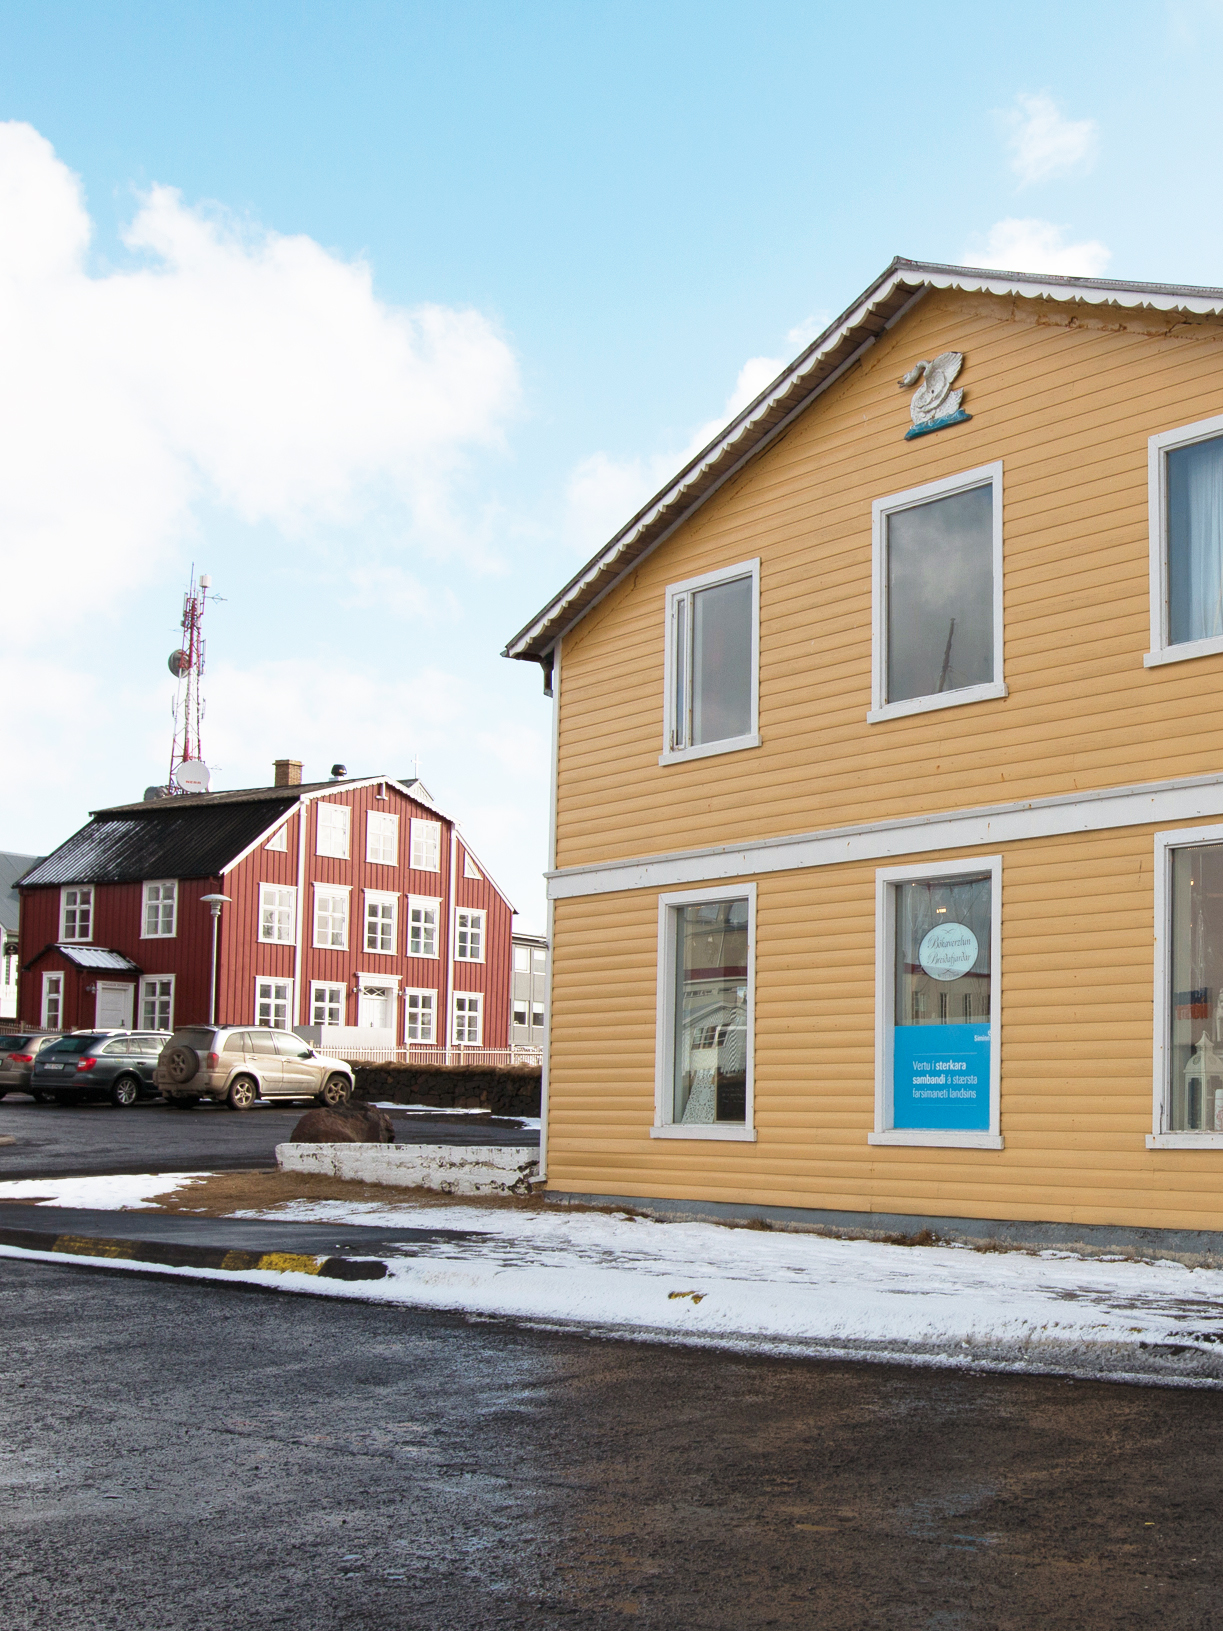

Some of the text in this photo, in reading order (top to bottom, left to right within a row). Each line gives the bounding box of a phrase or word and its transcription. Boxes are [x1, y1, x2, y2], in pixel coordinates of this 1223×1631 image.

[912, 1060, 931, 1071] Vertu
[935, 1059, 966, 1071] sterkara
[912, 1074, 946, 1084] sambandi
[952, 1075, 978, 1084] stærsta
[949, 1087, 977, 1098] landsins
